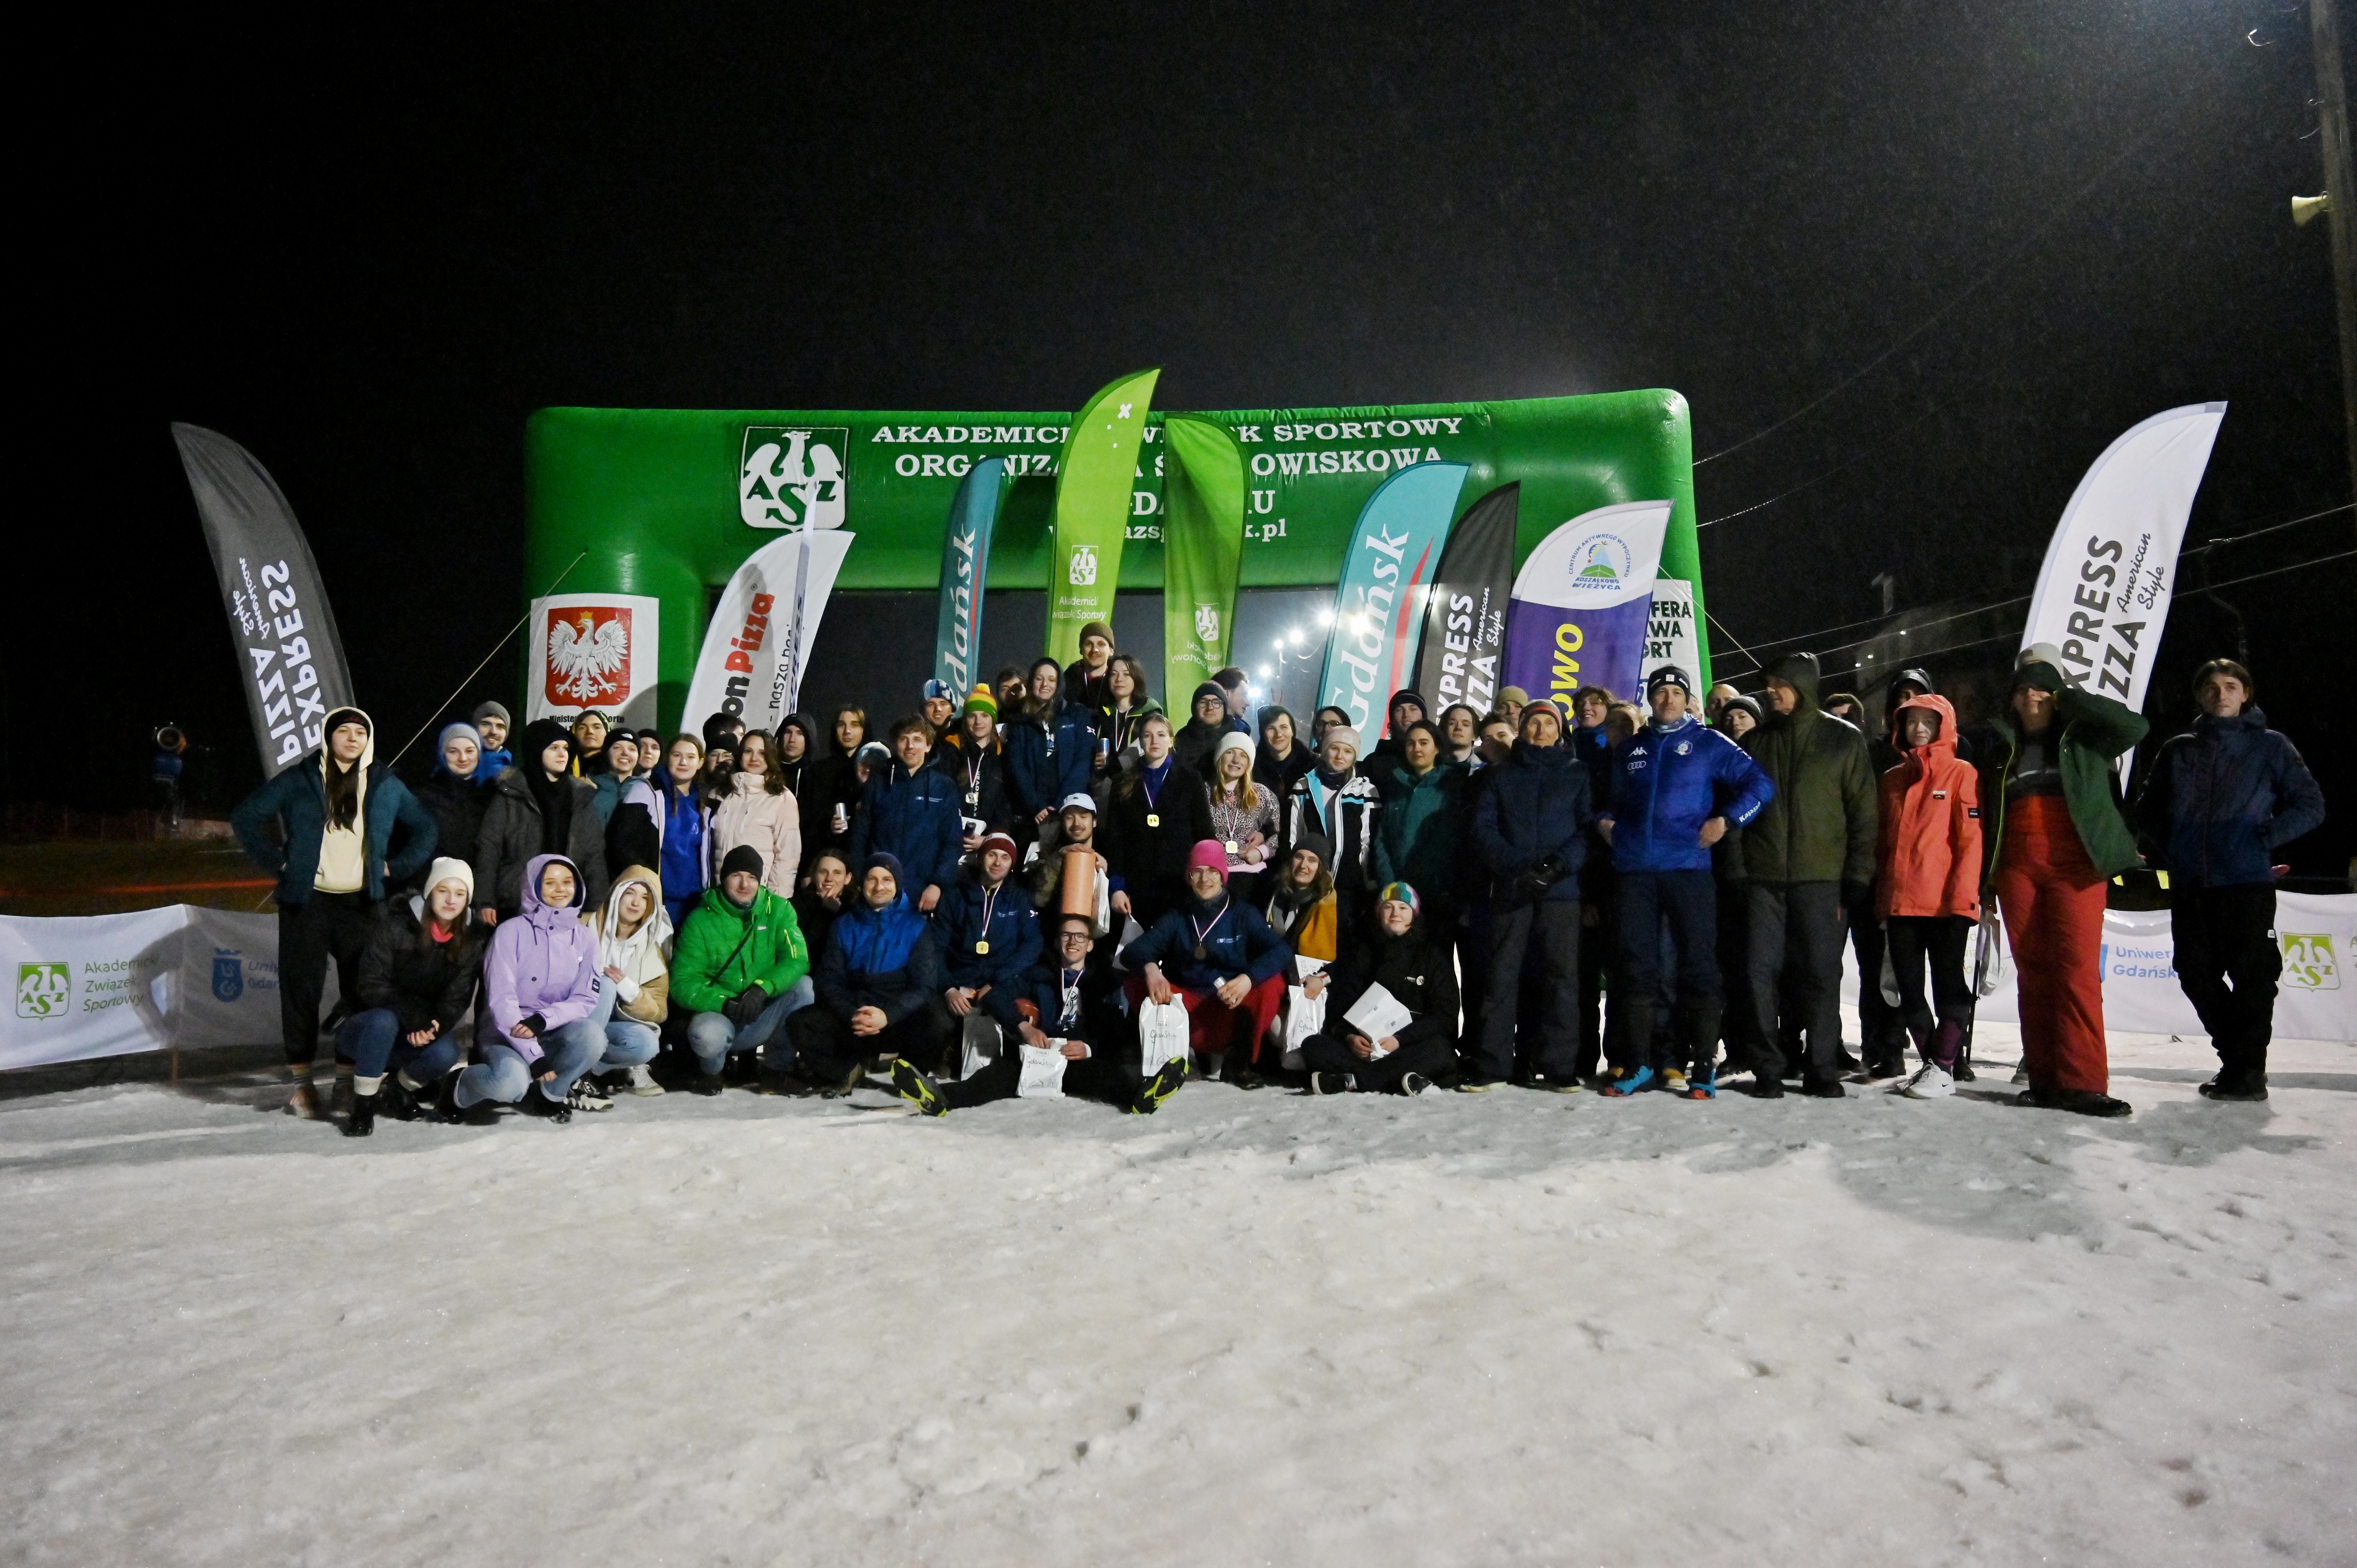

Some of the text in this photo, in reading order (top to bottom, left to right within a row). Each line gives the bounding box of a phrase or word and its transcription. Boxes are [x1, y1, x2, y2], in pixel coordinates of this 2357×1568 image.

[872, 426, 1070, 443] AKADEMIC
[1274, 418, 1462, 441] SPORTOWY
[1569, 534, 1631, 577] CENTRUM AKTYWNEGO WYPOCZYNKU
[2117, 533, 2151, 613] American
[2138, 567, 2165, 610] Style
[944, 523, 976, 713] dańsk
[1331, 523, 1409, 733] Gdańsk
[1473, 586, 1489, 651] American
[1487, 610, 1504, 646] Style
[2061, 535, 2122, 692] XPRESS
[1435, 593, 1473, 726] XPRESS
[2097, 622, 2147, 699] ZZA
[1466, 655, 1497, 720] ZZA
[1739, 801, 1761, 823] Kappa
[2113, 964, 2176, 978] Gdańsk
[2116, 945, 2173, 959] Uniwer
[83, 994, 143, 1013] Sportowy
[85, 976, 136, 993] Związek
